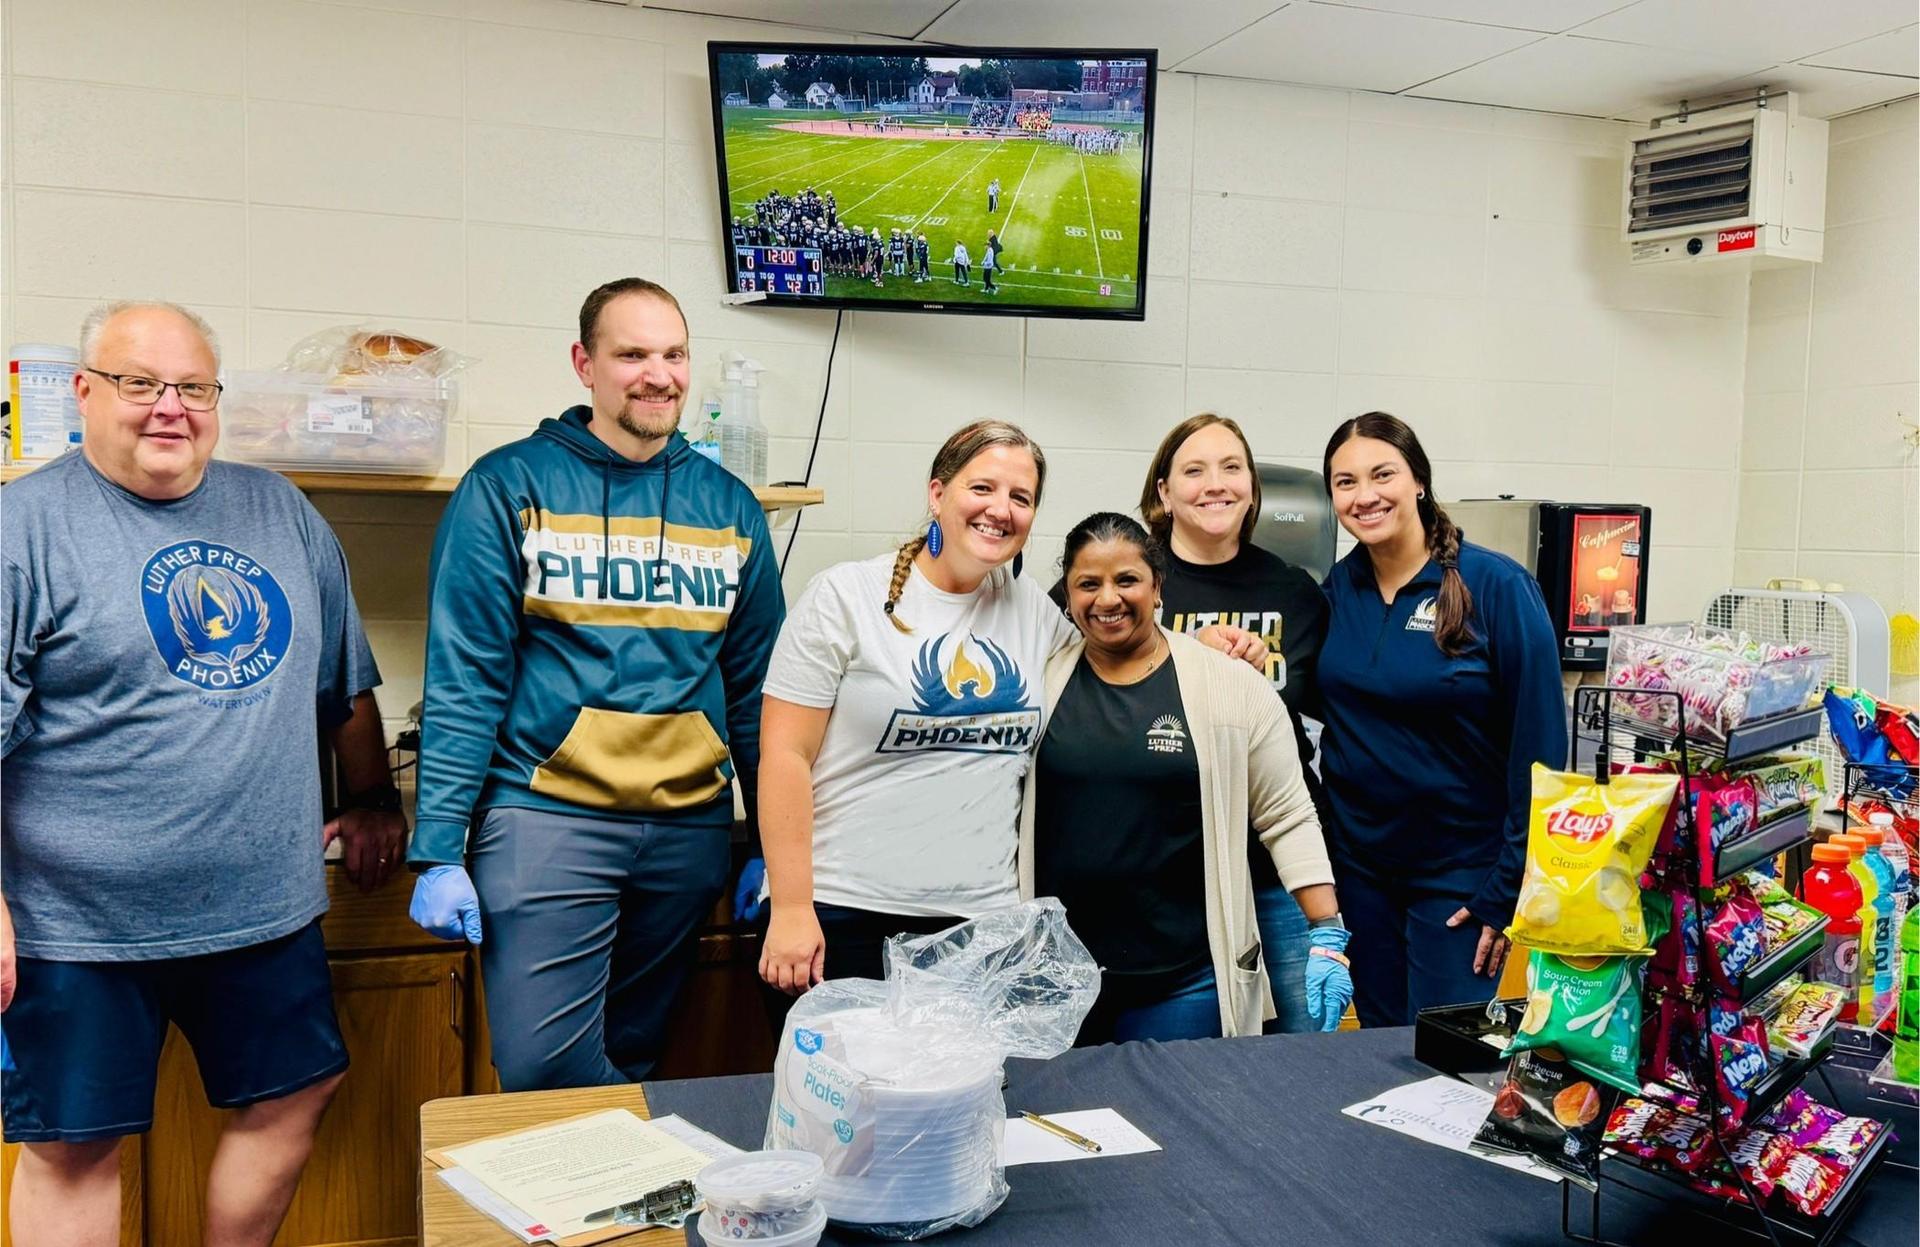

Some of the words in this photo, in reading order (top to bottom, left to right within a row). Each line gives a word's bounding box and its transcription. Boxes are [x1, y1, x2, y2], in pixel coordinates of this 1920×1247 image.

[1719, 230, 1753, 243] Dayton
[746, 256, 754, 269] 0
[767, 250, 796, 264] 12:00
[812, 260, 820, 272] 0
[768, 280, 775, 292] 6
[787, 281, 801, 293] 42
[1274, 512, 1305, 522] SofPull
[556, 536, 656, 555] LUTHER
[667, 545, 723, 563] PREP
[146, 546, 203, 594] LUTHER
[207, 549, 262, 577] PREP
[537, 551, 740, 607] PHOENIX
[176, 648, 277, 686] PHOENIX
[199, 686, 272, 710] WATERTOWN
[893, 726, 1034, 746] PHOENIX
[1148, 738, 1183, 748] LUTHER
[1154, 745, 1177, 753] PREP
[1768, 780, 1798, 801] PUNCH
[1550, 856, 1592, 870] Classic
[1543, 969, 1569, 982] Sour
[1570, 975, 1603, 988] Cream
[1561, 982, 1591, 996] Onion
[1519, 1058, 1563, 1081] Barbecue
[804, 1071, 846, 1111] Plates
